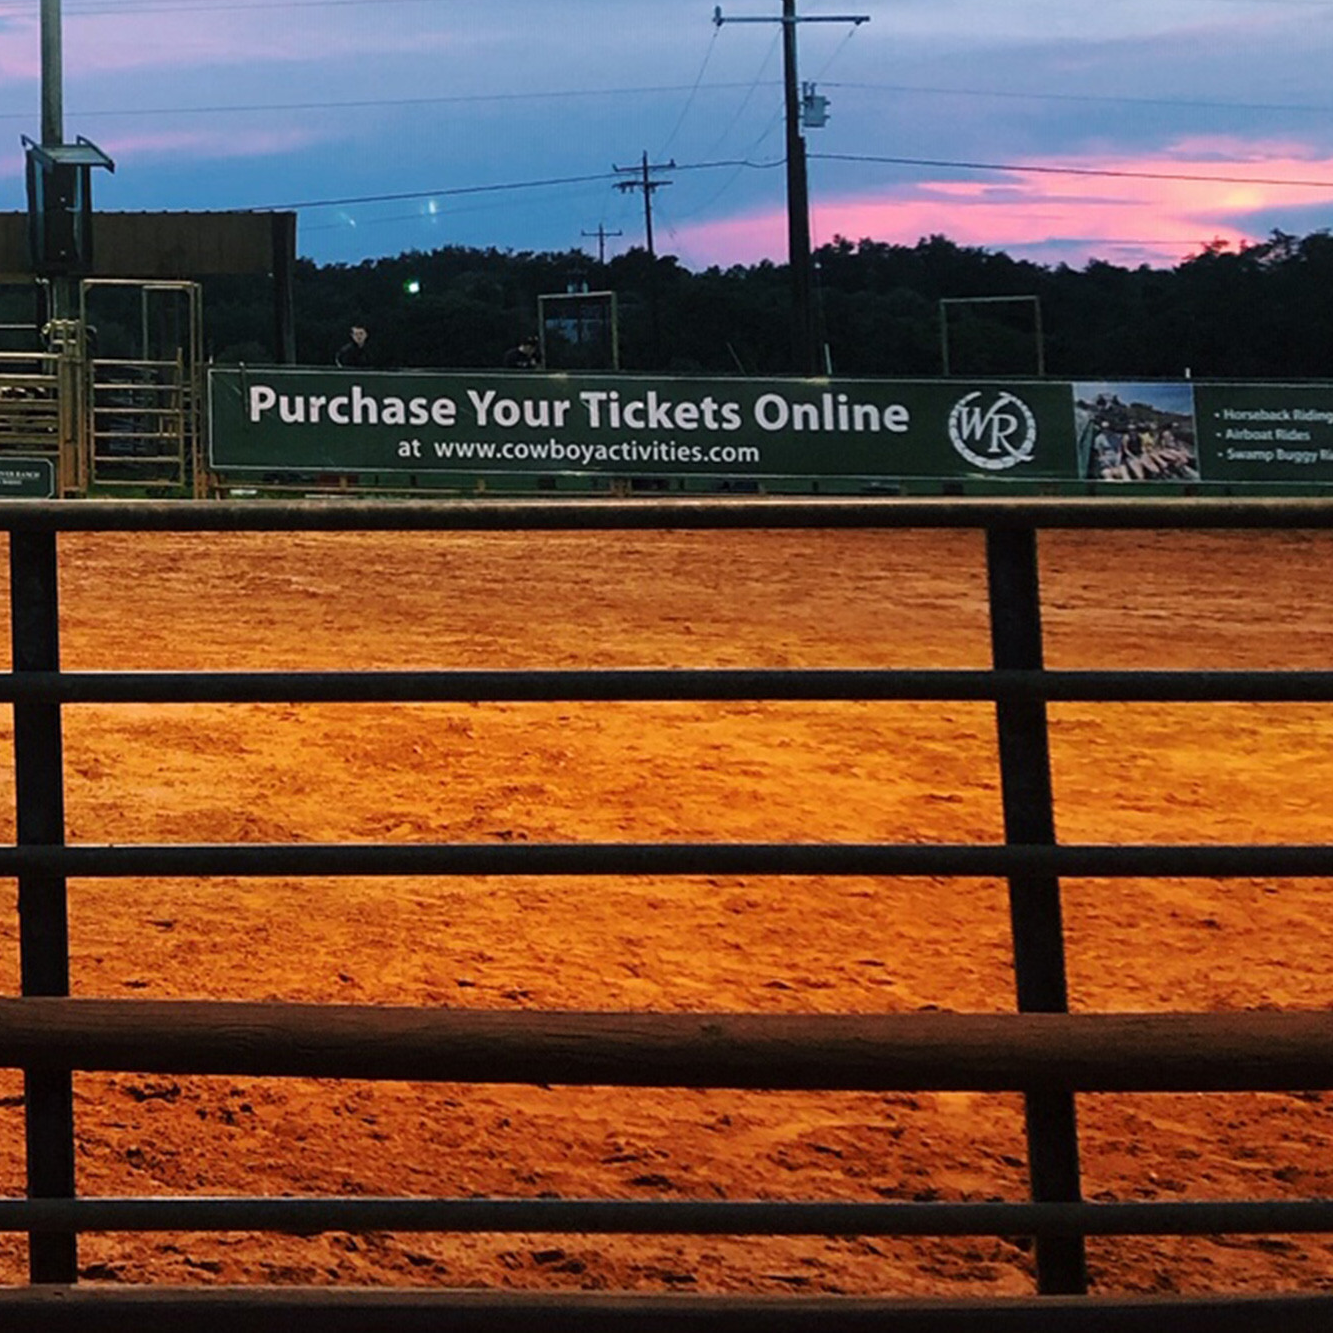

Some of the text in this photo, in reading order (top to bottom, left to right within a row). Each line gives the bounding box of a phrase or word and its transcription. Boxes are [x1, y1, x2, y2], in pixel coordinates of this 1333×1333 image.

[249, 385, 910, 433] Purchase Your Tickets Online
[1223, 409, 1291, 421] Horseback
[1225, 429, 1311, 441] Airboat Rides
[397, 439, 759, 464] at www.cowboyactivities.com
[1227, 448, 1274, 463] Swamp
[1276, 449, 1318, 464] Buggy
